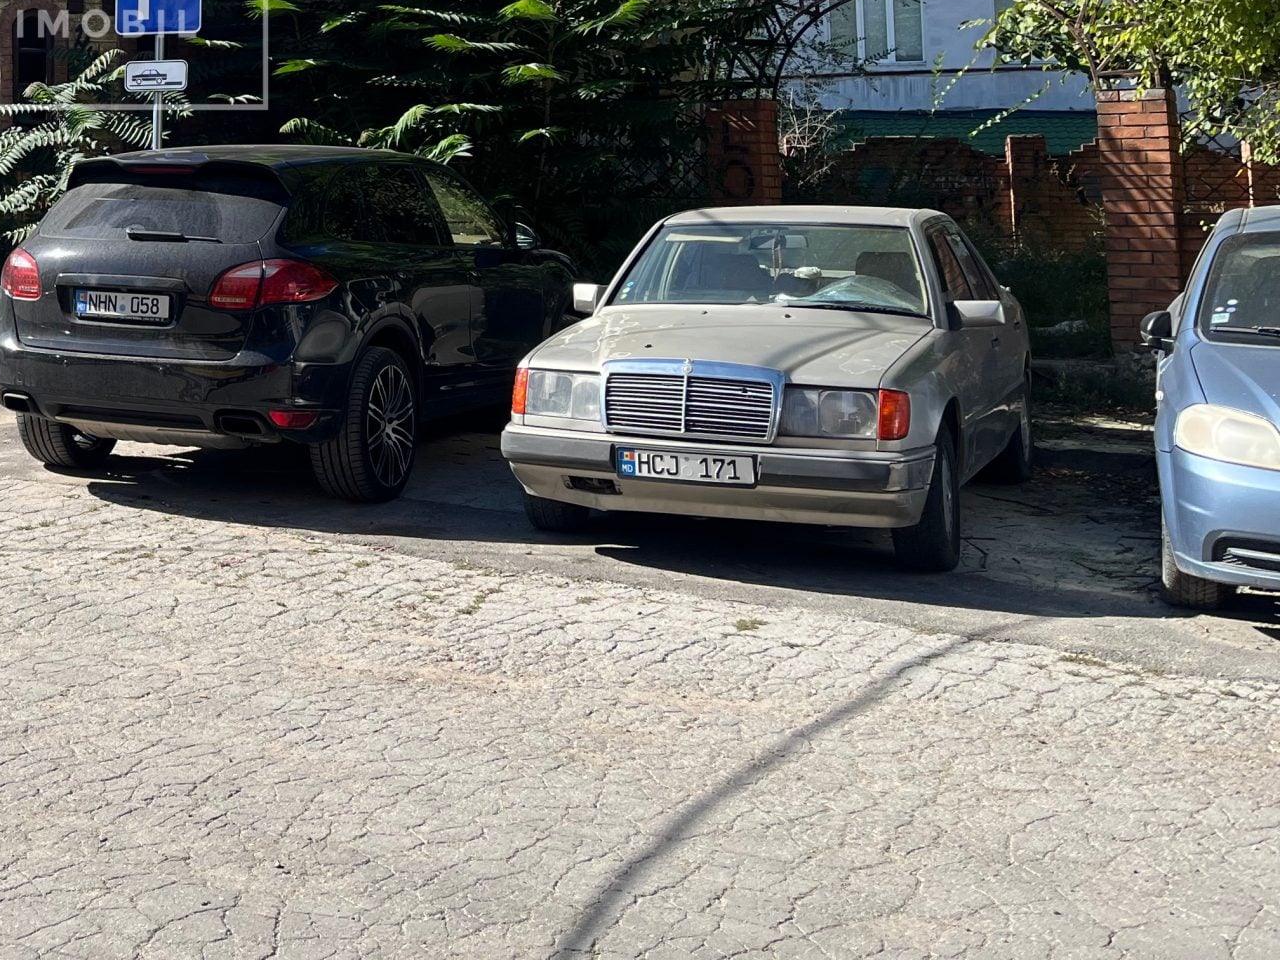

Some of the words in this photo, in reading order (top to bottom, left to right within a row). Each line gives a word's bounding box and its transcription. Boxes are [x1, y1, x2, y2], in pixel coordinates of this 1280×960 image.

[88, 293, 118, 313] NHN
[130, 296, 160, 315] 058
[621, 463, 634, 473] MD
[637, 453, 680, 476] HCJ
[698, 457, 741, 481] 171
